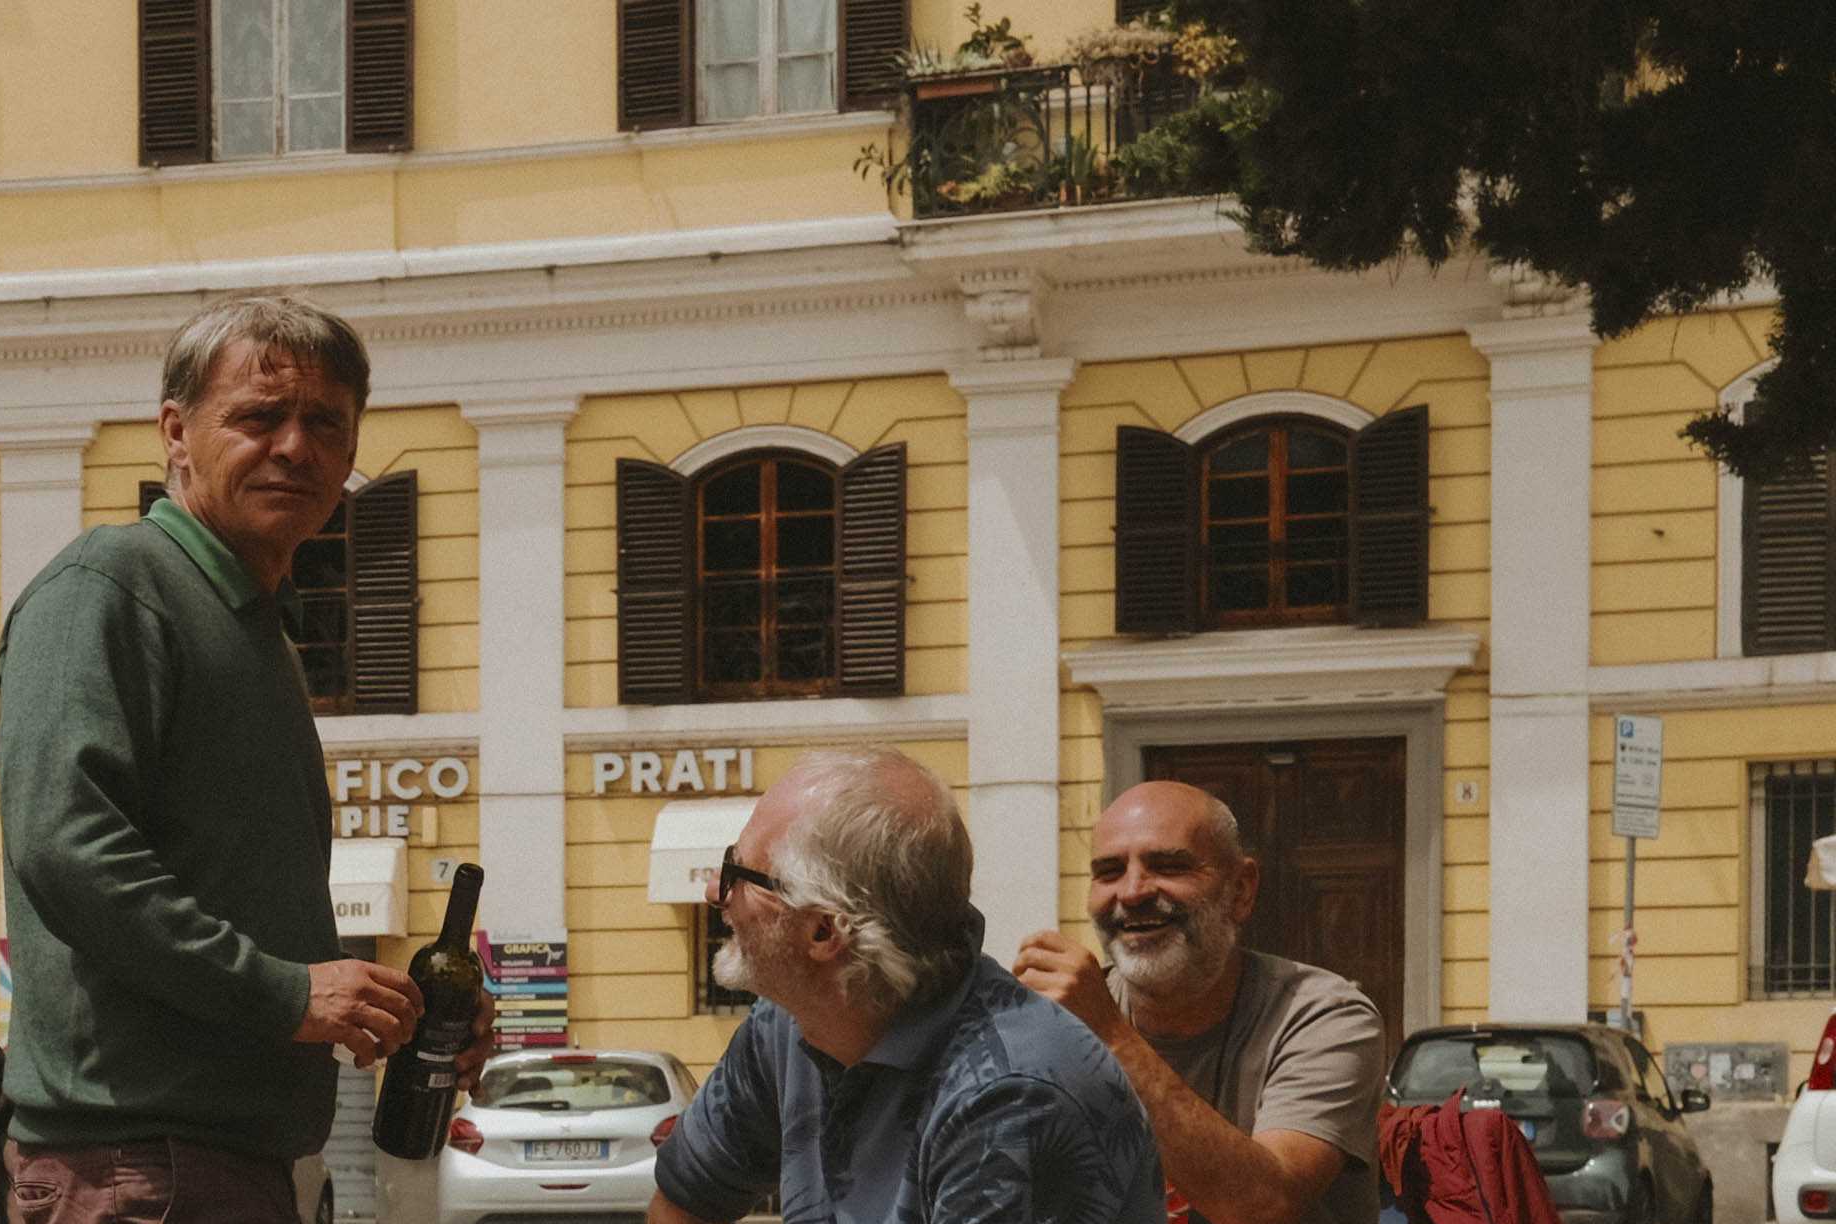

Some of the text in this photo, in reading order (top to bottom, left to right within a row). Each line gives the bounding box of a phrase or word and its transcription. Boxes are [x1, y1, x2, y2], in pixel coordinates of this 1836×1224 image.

[593, 748, 753, 795] PRATI
[332, 804, 410, 837] PIE
[438, 862, 448, 878] 7
[503, 943, 551, 955] GRAFICA
